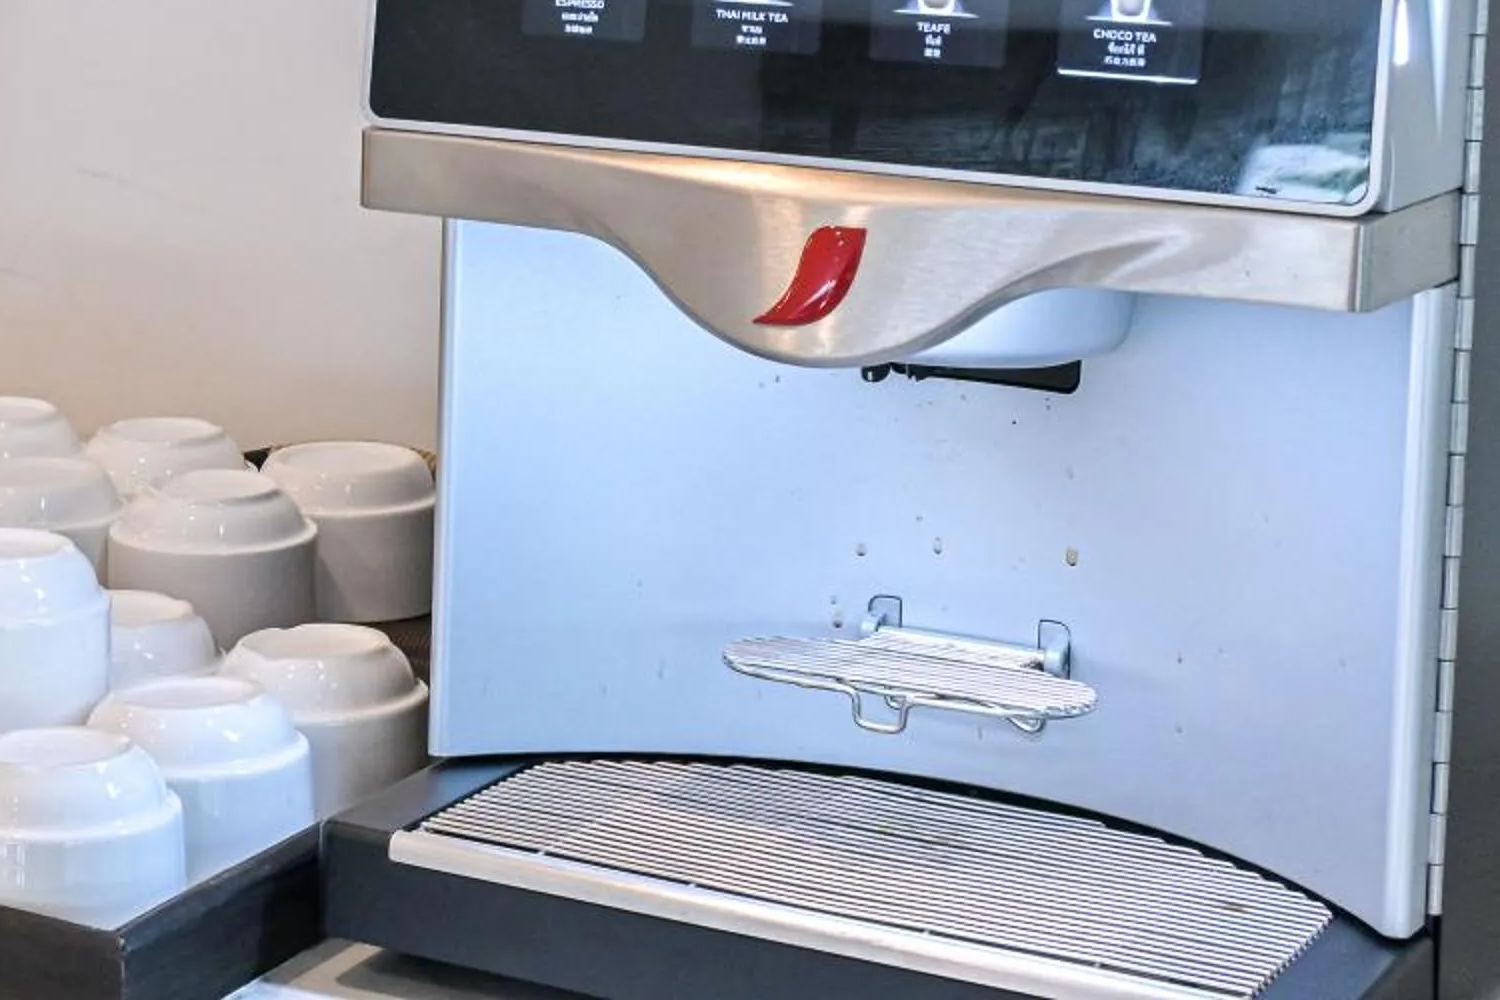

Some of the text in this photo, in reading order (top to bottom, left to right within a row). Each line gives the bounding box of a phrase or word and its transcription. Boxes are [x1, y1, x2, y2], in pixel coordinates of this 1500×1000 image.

[715, 8, 789, 23] THAI MILK TEA
[1093, 27, 1157, 43] CHOCO TEA
